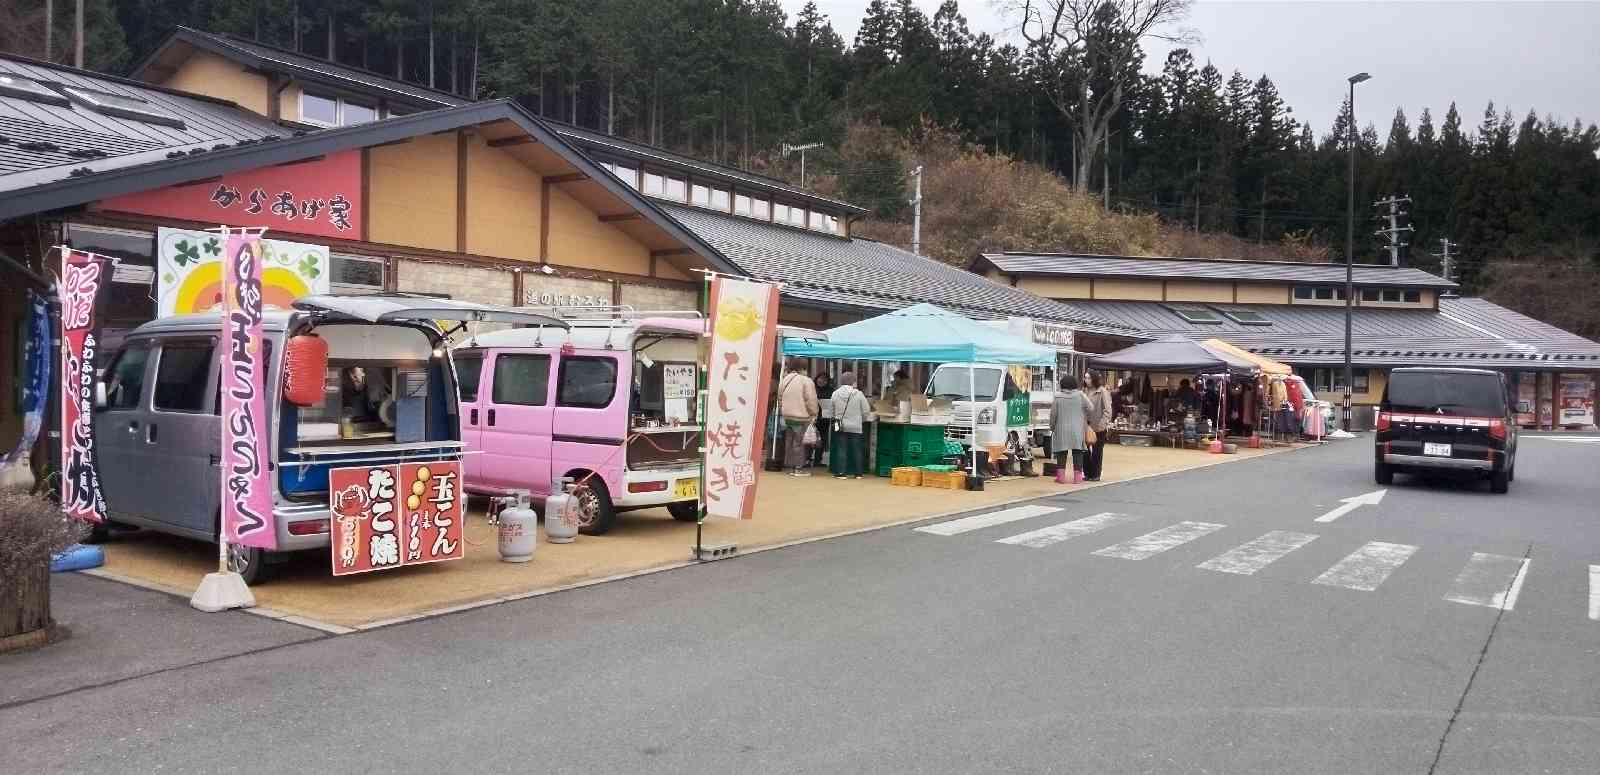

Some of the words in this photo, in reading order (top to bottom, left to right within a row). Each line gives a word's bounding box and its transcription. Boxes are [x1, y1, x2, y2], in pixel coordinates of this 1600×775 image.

[210, 184, 353, 232] からあげ家
[707, 351, 748, 501] たい焼き
[368, 469, 398, 566] たこ焼
[428, 471, 458, 556] 玉こん
